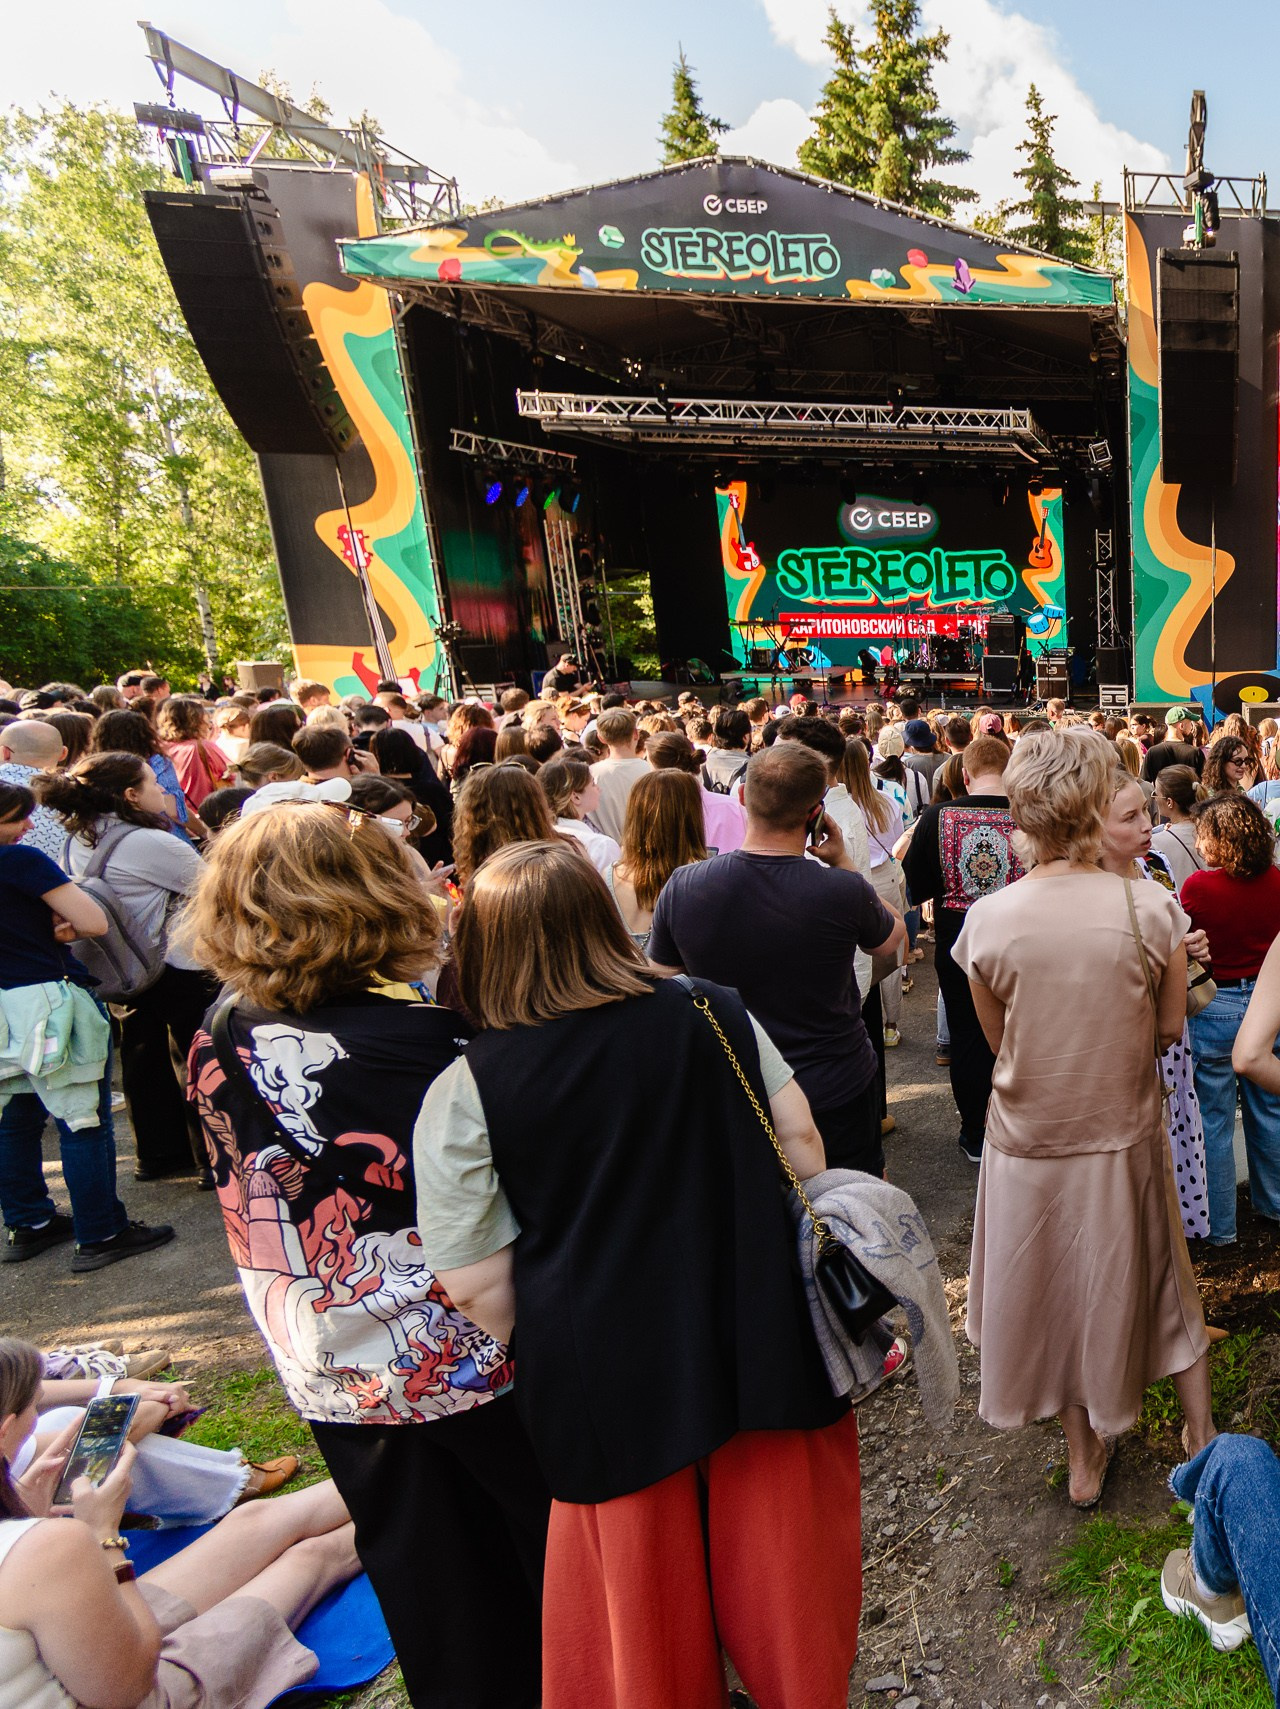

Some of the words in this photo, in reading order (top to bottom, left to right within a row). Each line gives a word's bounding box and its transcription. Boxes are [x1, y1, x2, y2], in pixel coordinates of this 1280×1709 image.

[725, 198, 768, 214] СБЕР
[642, 229, 840, 278] STEREOLETO
[877, 511, 931, 528] СБЕР
[777, 548, 1016, 601] STEREOLETO
[908, 619, 936, 635] САД
